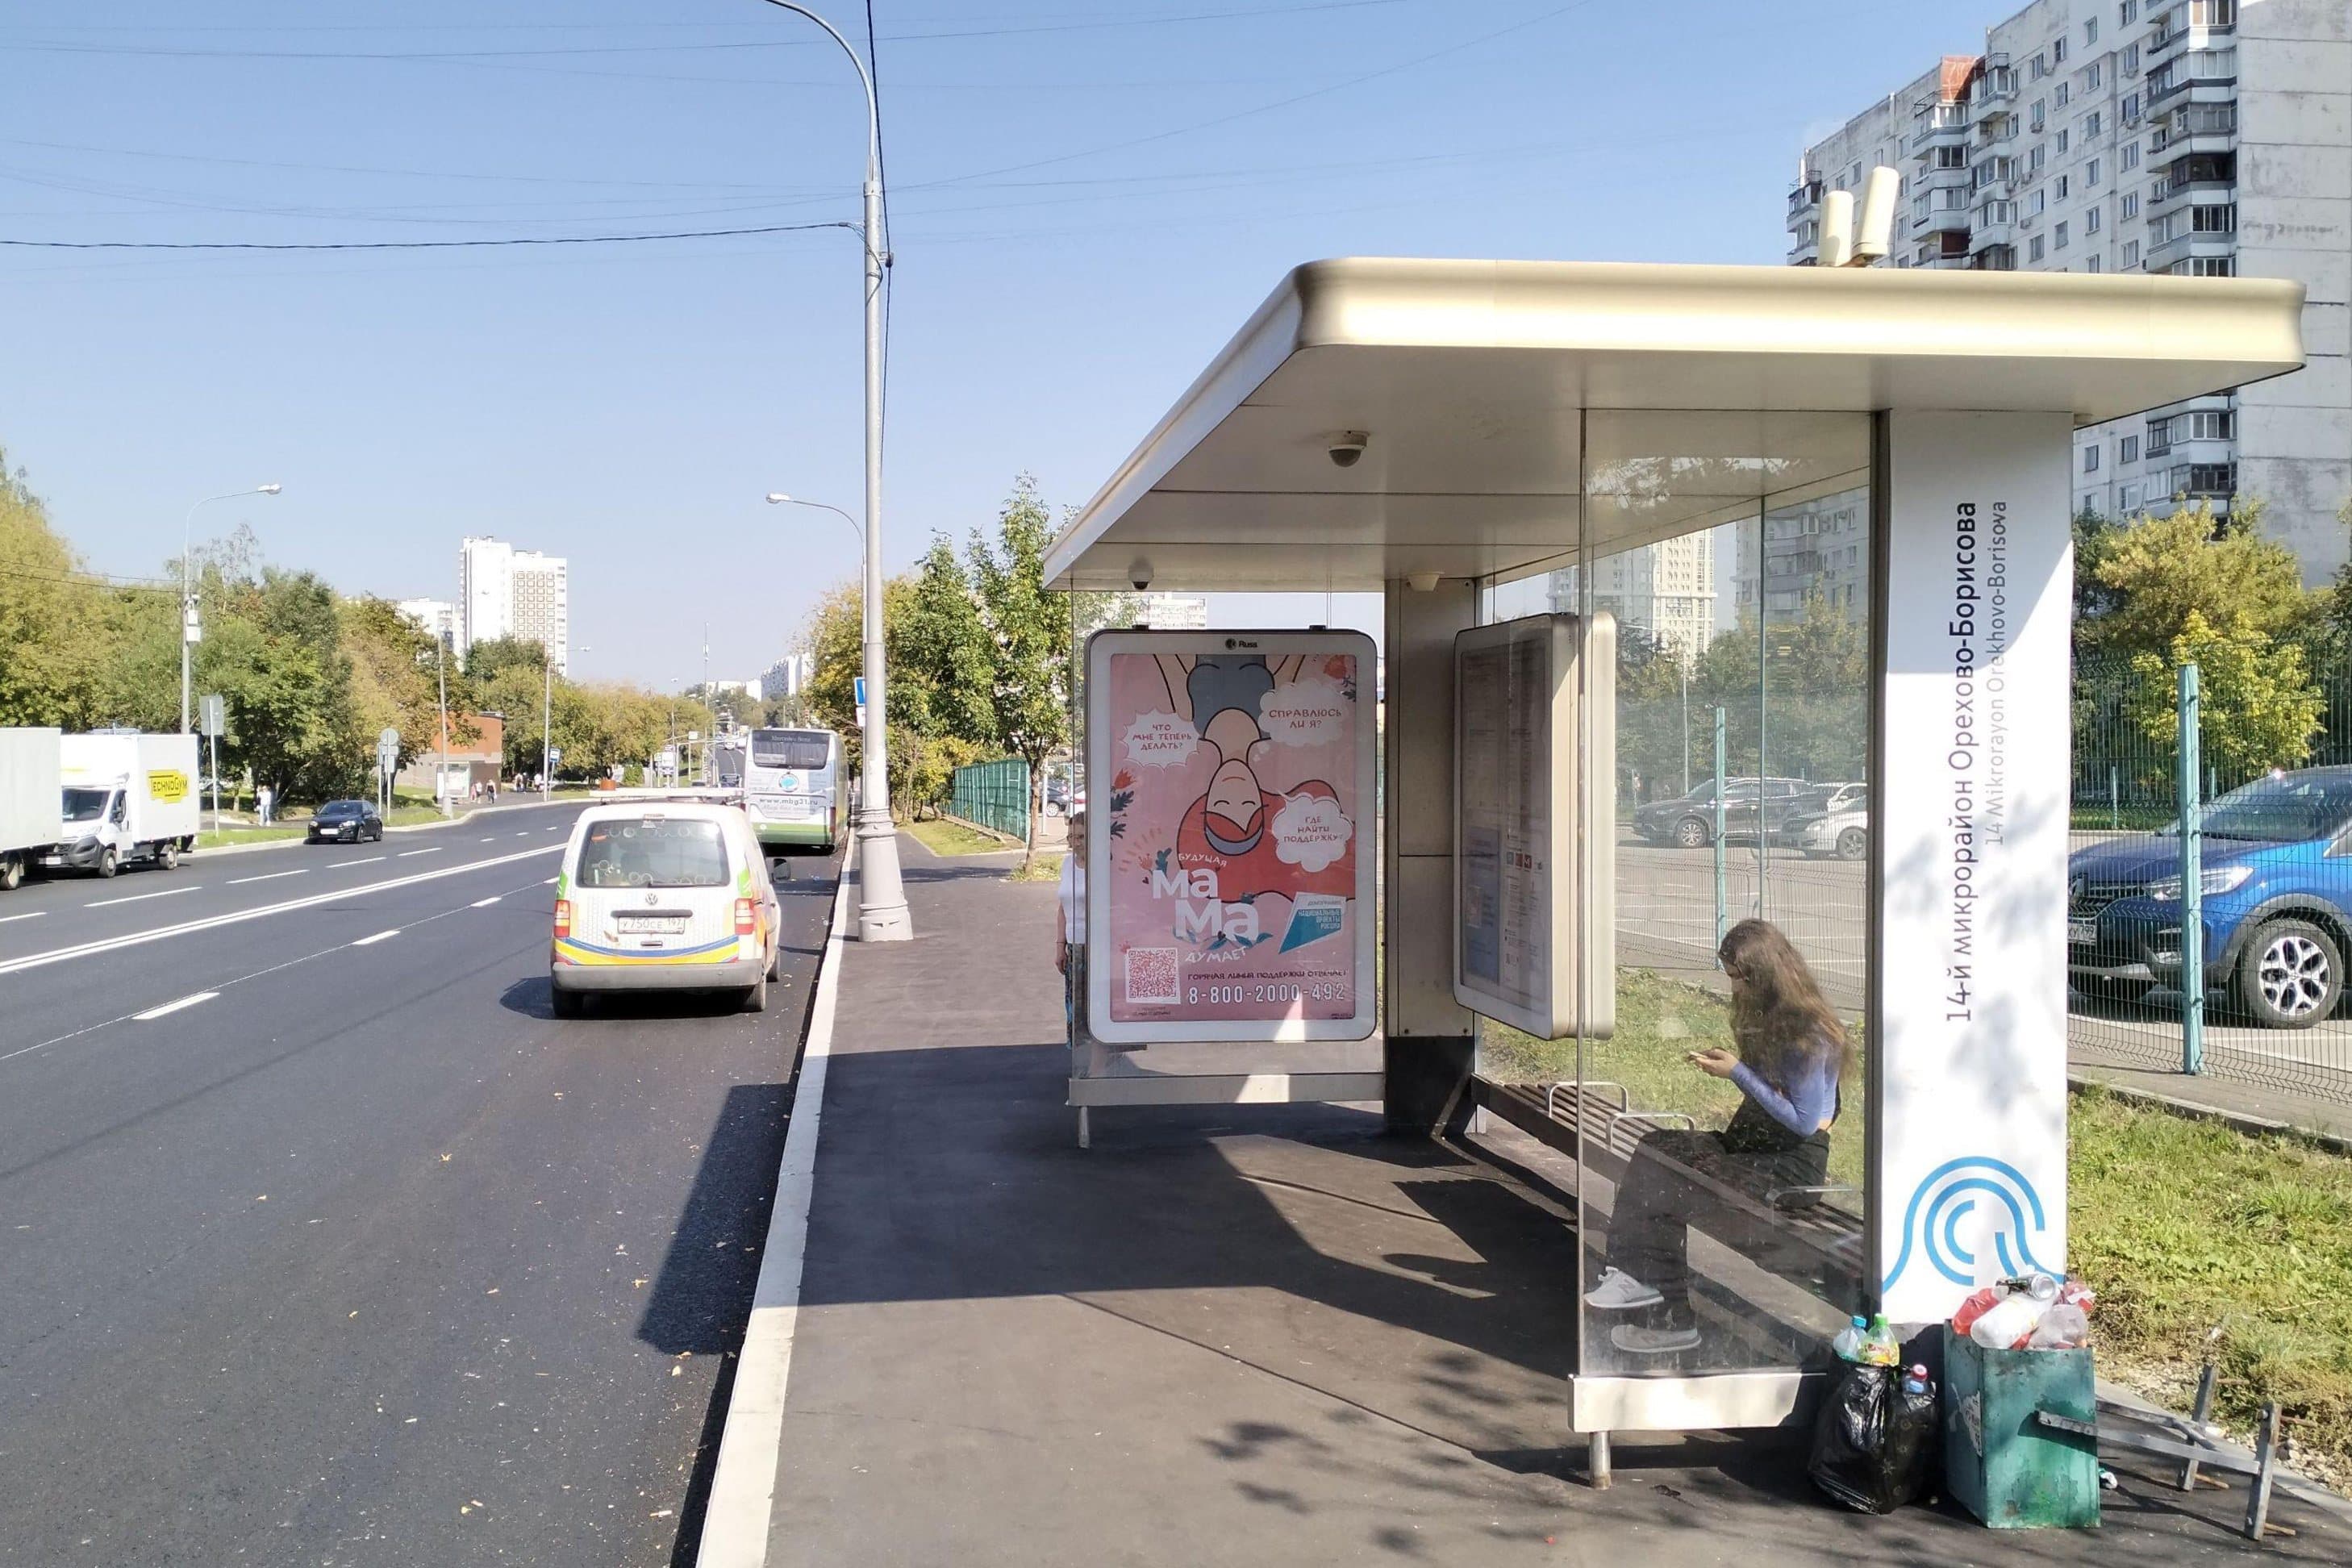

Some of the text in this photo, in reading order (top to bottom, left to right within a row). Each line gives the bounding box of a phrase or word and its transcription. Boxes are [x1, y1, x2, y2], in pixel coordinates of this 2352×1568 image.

[1985, 501, 2009, 846] 14 Mikrorayon Orekhovo-Borisova
[1269, 708, 1342, 718] СПРАВЛЮСЬ
[1152, 724, 1171, 732] ЧТО
[1290, 719, 1322, 728] ЛИ Я?
[1132, 732, 1192, 741] МНЕ ТЕПЕРЬ
[1141, 742, 1183, 751] ДЕЛАТЬ?
[1946, 502, 1981, 1021] 14-й микрорайон Орехово-Борисова
[1297, 824, 1329, 833] НАЙТИ
[1178, 853, 1227, 867] БУДУЩАЯ
[1185, 946, 1247, 963] ДУМАЕТ
[1256, 970, 1305, 979] ПОДДЕРЖКИ
[1188, 982, 1345, 1005] 8-800-2000-492
